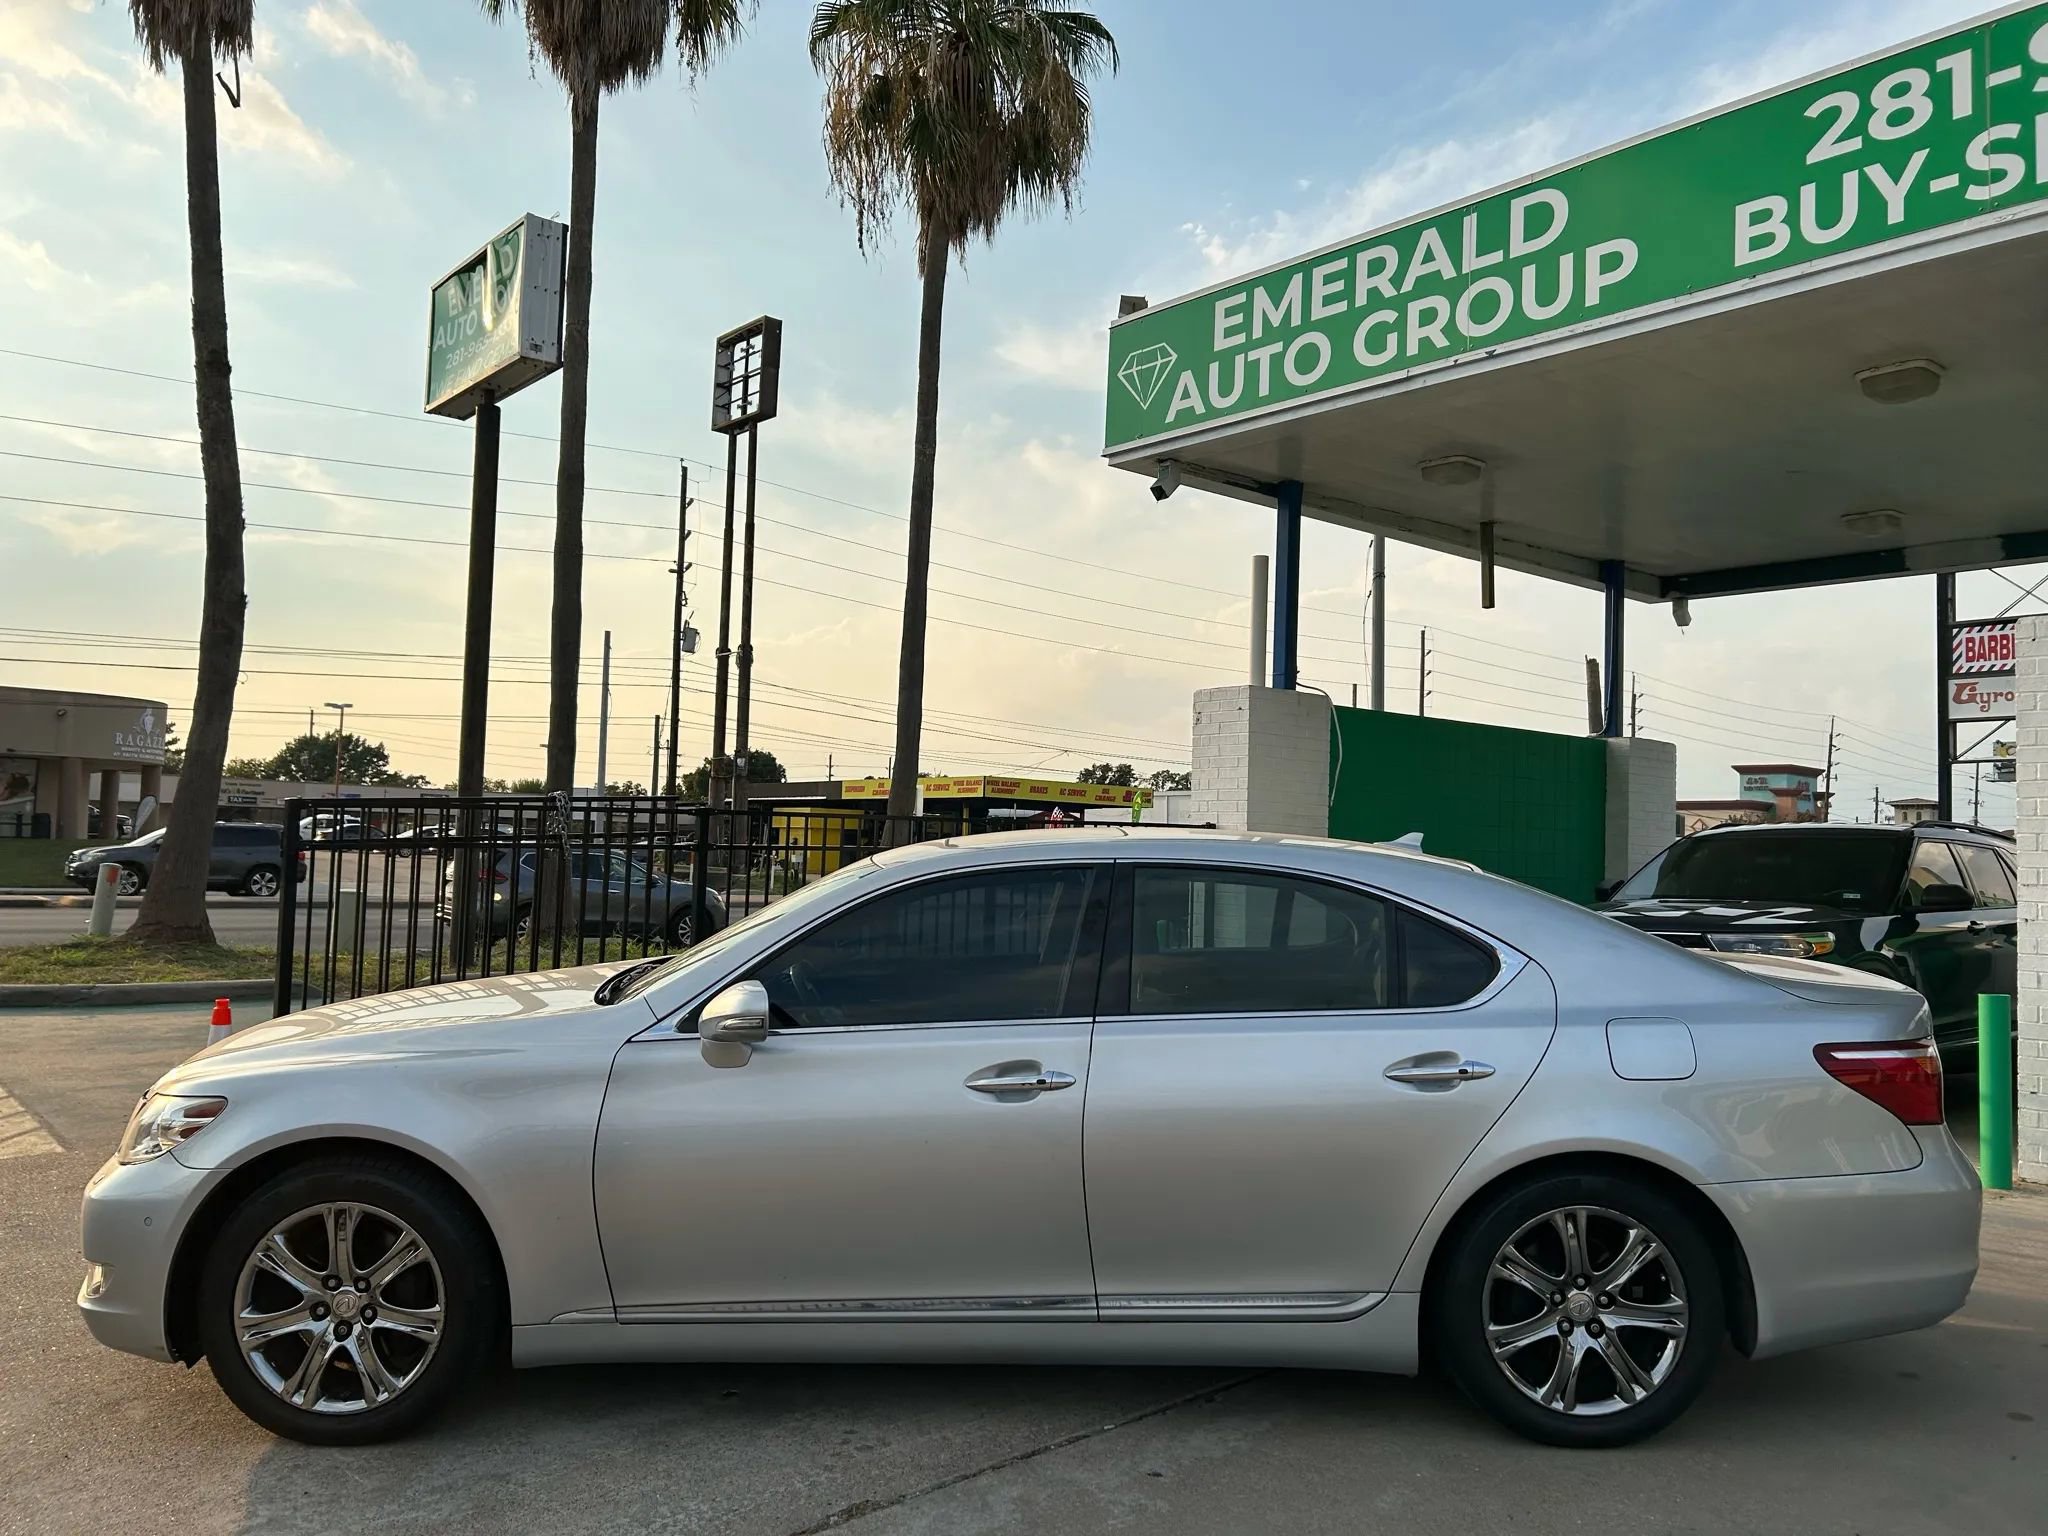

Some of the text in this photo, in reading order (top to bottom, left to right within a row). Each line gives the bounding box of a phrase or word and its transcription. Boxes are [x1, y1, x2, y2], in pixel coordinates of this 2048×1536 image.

[446, 245, 514, 317] EMELD
[1213, 188, 1569, 352] EMERALD
[433, 309, 478, 352] AUTO
[1165, 238, 1639, 423] AUTO GROUP
[1965, 633, 2016, 663] BARB
[933, 783, 950, 792] SERVICE
[1029, 786, 1048, 794] BRAKES
[1067, 788, 1088, 797] SERVICE
